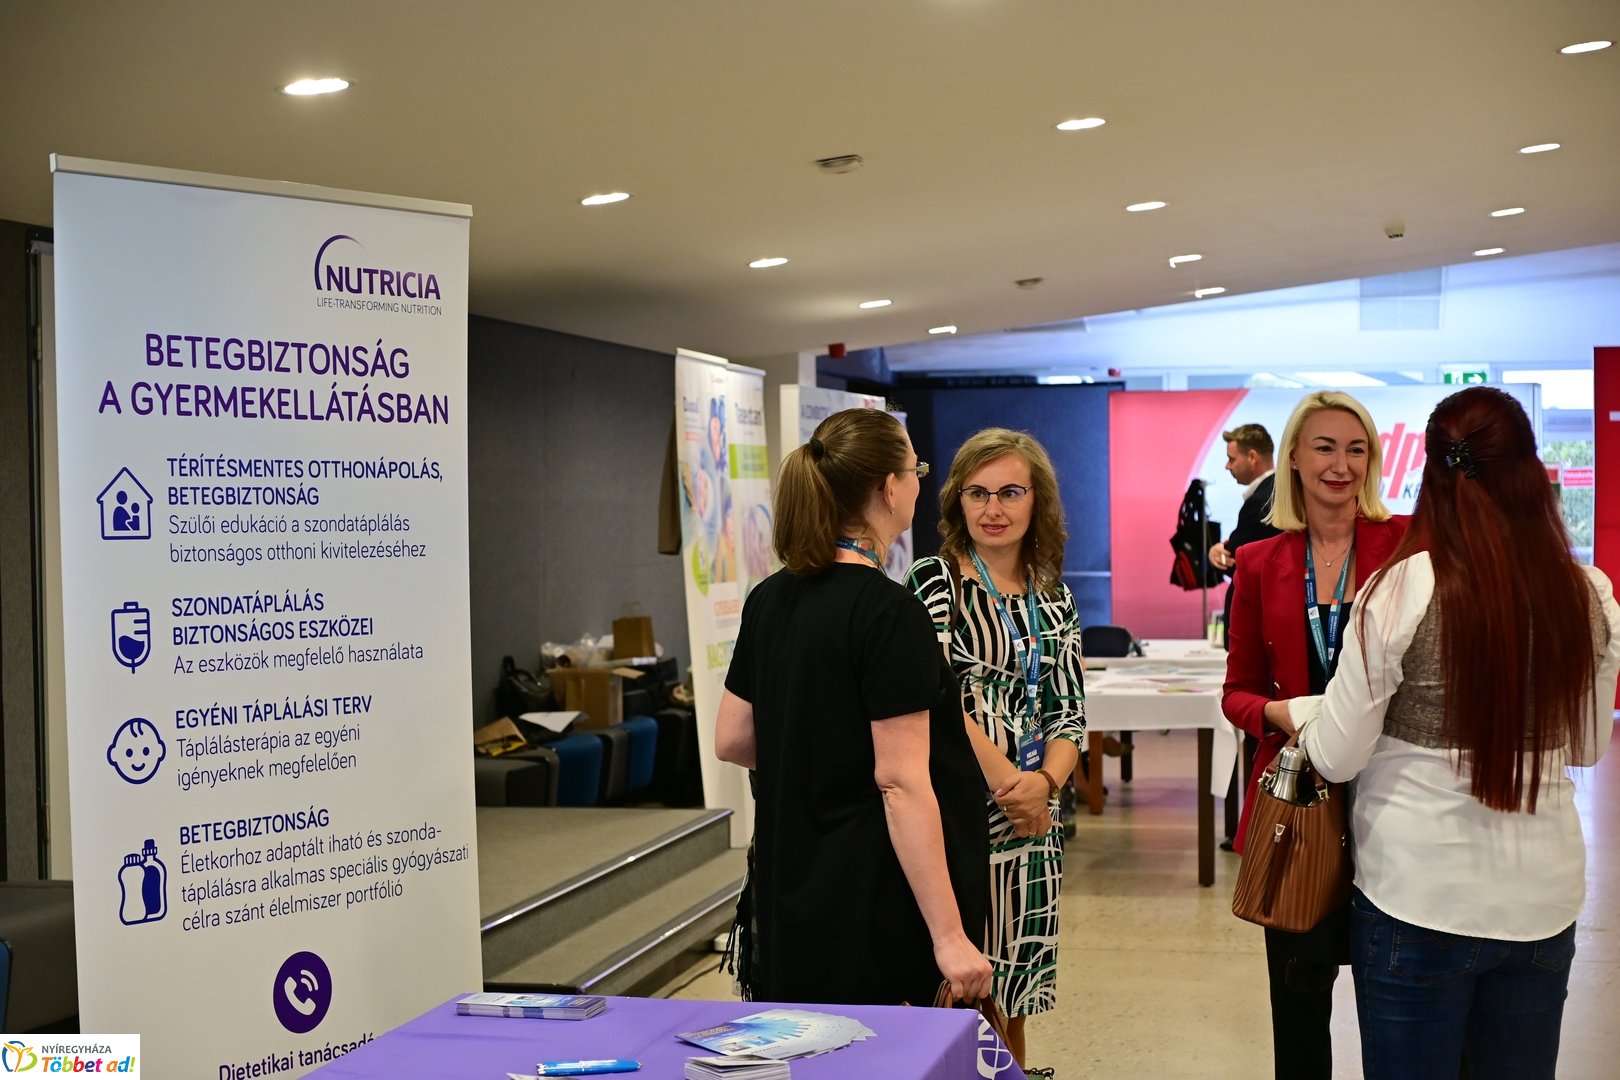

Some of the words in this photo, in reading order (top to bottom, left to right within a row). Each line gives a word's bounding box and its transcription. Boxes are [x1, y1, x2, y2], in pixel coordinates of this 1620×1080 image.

[325, 265, 442, 300] NUTRICIA
[317, 297, 400, 313] LIFE-TRANSFORMING
[401, 303, 442, 316] NUTRITION
[146, 333, 409, 379] BETEGBIZTONSÁG
[99, 381, 122, 414] A
[131, 381, 448, 424] GYERMEKELLÁTÁSBAN
[167, 453, 304, 478] TÉRÍTÉSMENTES
[308, 456, 442, 483] OTTHONÁPOLÁS,
[168, 482, 319, 505] BETEGBIZTONSÁG
[169, 514, 215, 534] Szülői
[221, 514, 288, 534] edukáció
[291, 519, 300, 533] a
[304, 513, 410, 536] szondatáplálás
[170, 543, 262, 566] biztonságos
[267, 541, 315, 560] otthoni
[321, 539, 426, 559] kivitelezéséhez
[172, 588, 324, 617] SZONDATÁPLÁLÁS
[173, 618, 294, 645] BIZTONSÁGOS
[299, 615, 373, 639] ESZKÖZEI
[174, 655, 194, 674] Az
[199, 650, 269, 673] eszközök
[274, 645, 344, 671] megfelelő
[349, 642, 423, 663] használata
[176, 702, 237, 729] EGYÉNI
[242, 695, 328, 723] TÁPLÁLÁSI
[332, 695, 372, 715] TERV
[176, 731, 290, 761] Táplálásterápia
[295, 732, 310, 746] az
[315, 724, 360, 750] egyéni
[178, 758, 264, 791] igényeknek
[269, 752, 356, 779] megfelelően
[180, 805, 330, 845] BETEGBIZTONSÁG
[181, 846, 262, 874] Életkorhoz
[266, 836, 324, 863] adaptált
[328, 832, 362, 853] iható
[367, 834, 382, 847] és
[387, 822, 441, 845] szonda-
[182, 877, 256, 906] táplálásra
[261, 867, 325, 891] alkalmas
[329, 858, 388, 884] speciális
[392, 845, 468, 875] gyógyászati
[183, 909, 220, 931] célra
[226, 903, 265, 924] szánt
[269, 893, 341, 917] élelmiszer
[346, 879, 402, 909] portfólió
[219, 1050, 294, 1080] Dietetikai
